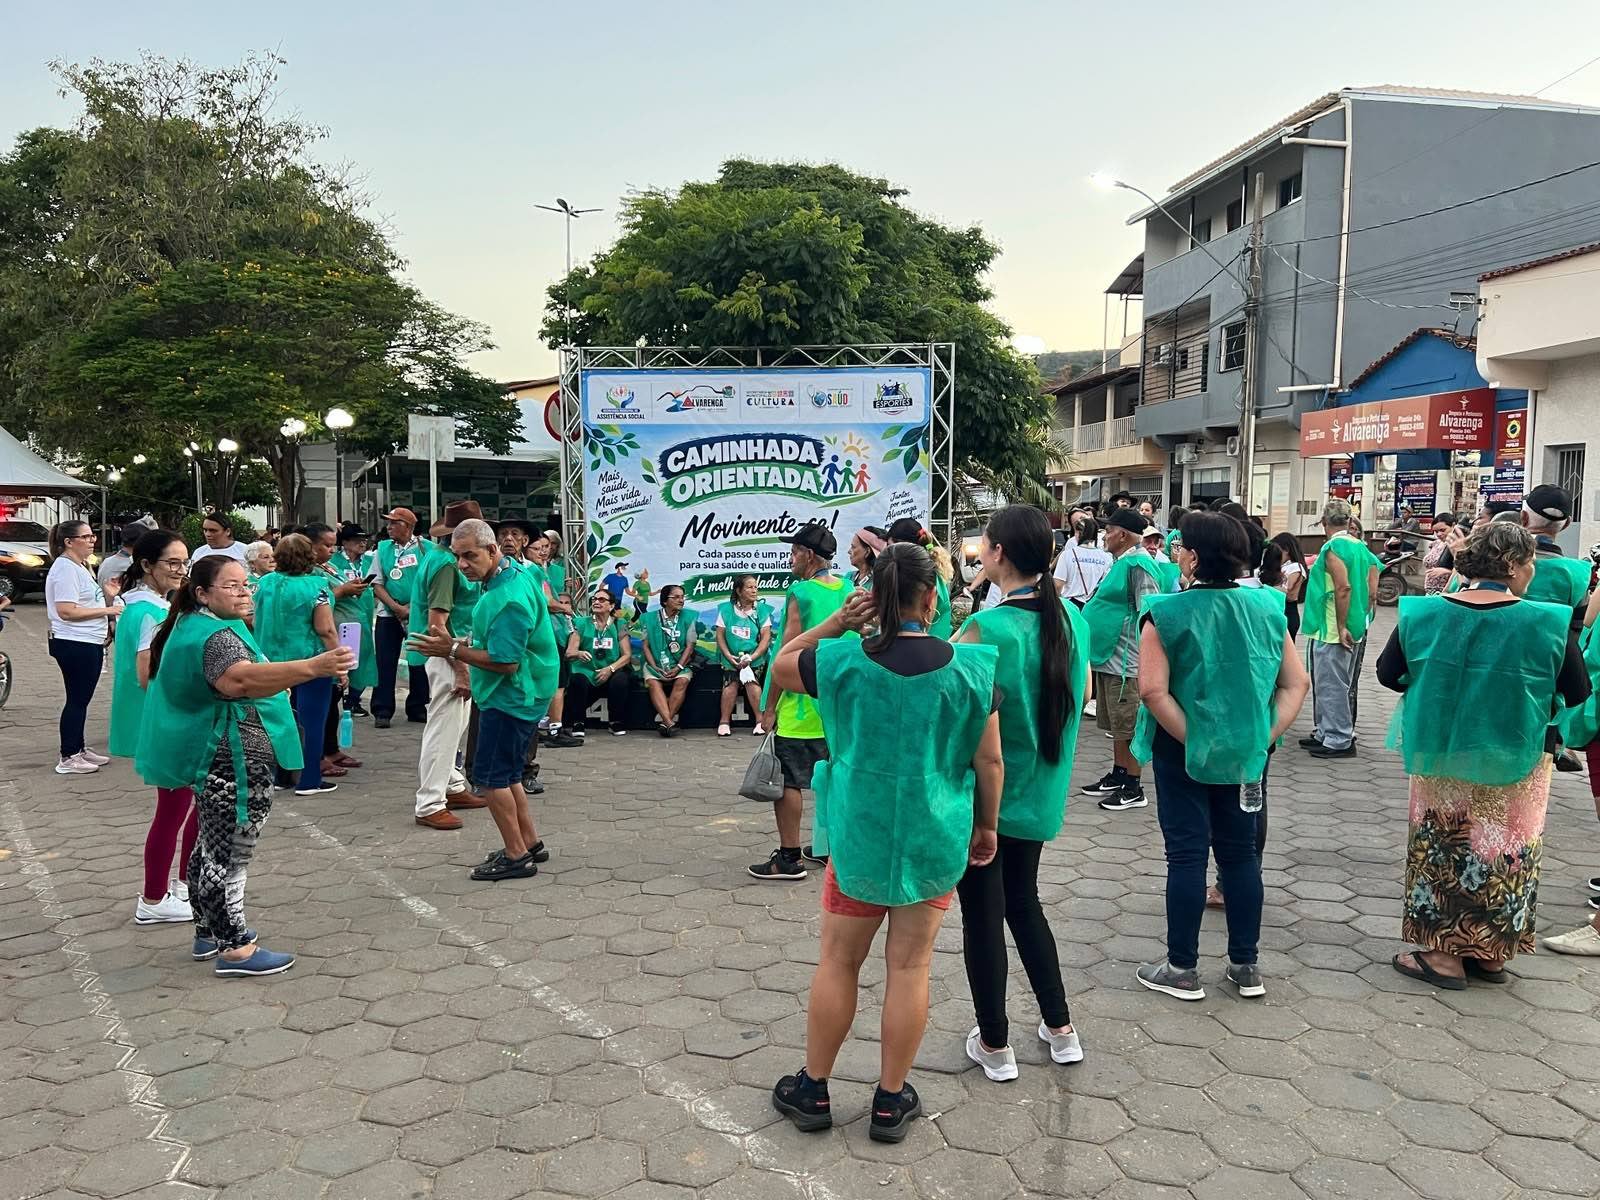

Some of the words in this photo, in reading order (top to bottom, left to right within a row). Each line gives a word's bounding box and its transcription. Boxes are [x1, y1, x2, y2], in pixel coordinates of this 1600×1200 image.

[746, 398, 795, 406] CULTURA
[875, 400, 910, 408] ESPORTES
[1440, 413, 1483, 431] Alvarenga
[1343, 422, 1390, 444] Alvarenga
[666, 439, 819, 473] CAMINHADA
[598, 469, 620, 485] Mais
[601, 477, 628, 495] saúde
[671, 466, 819, 503] ORIENTADA
[595, 494, 618, 510] Mais
[620, 486, 641, 501] vida
[610, 495, 652, 514] comunidade!
[890, 491, 910, 502] Juntos
[886, 506, 917, 521] Alvarenga
[890, 502, 899, 510] por
[698, 550, 721, 559] Cada
[724, 551, 752, 563] passo
[754, 550, 760, 559] é
[680, 562, 700, 572] para
[703, 562, 719, 570] sua
[721, 560, 749, 570] saúde
[758, 560, 793, 572] qualida
[693, 578, 705, 596] A
[708, 576, 734, 592] melh
[782, 576, 790, 589] é
[586, 697, 609, 722] 4
